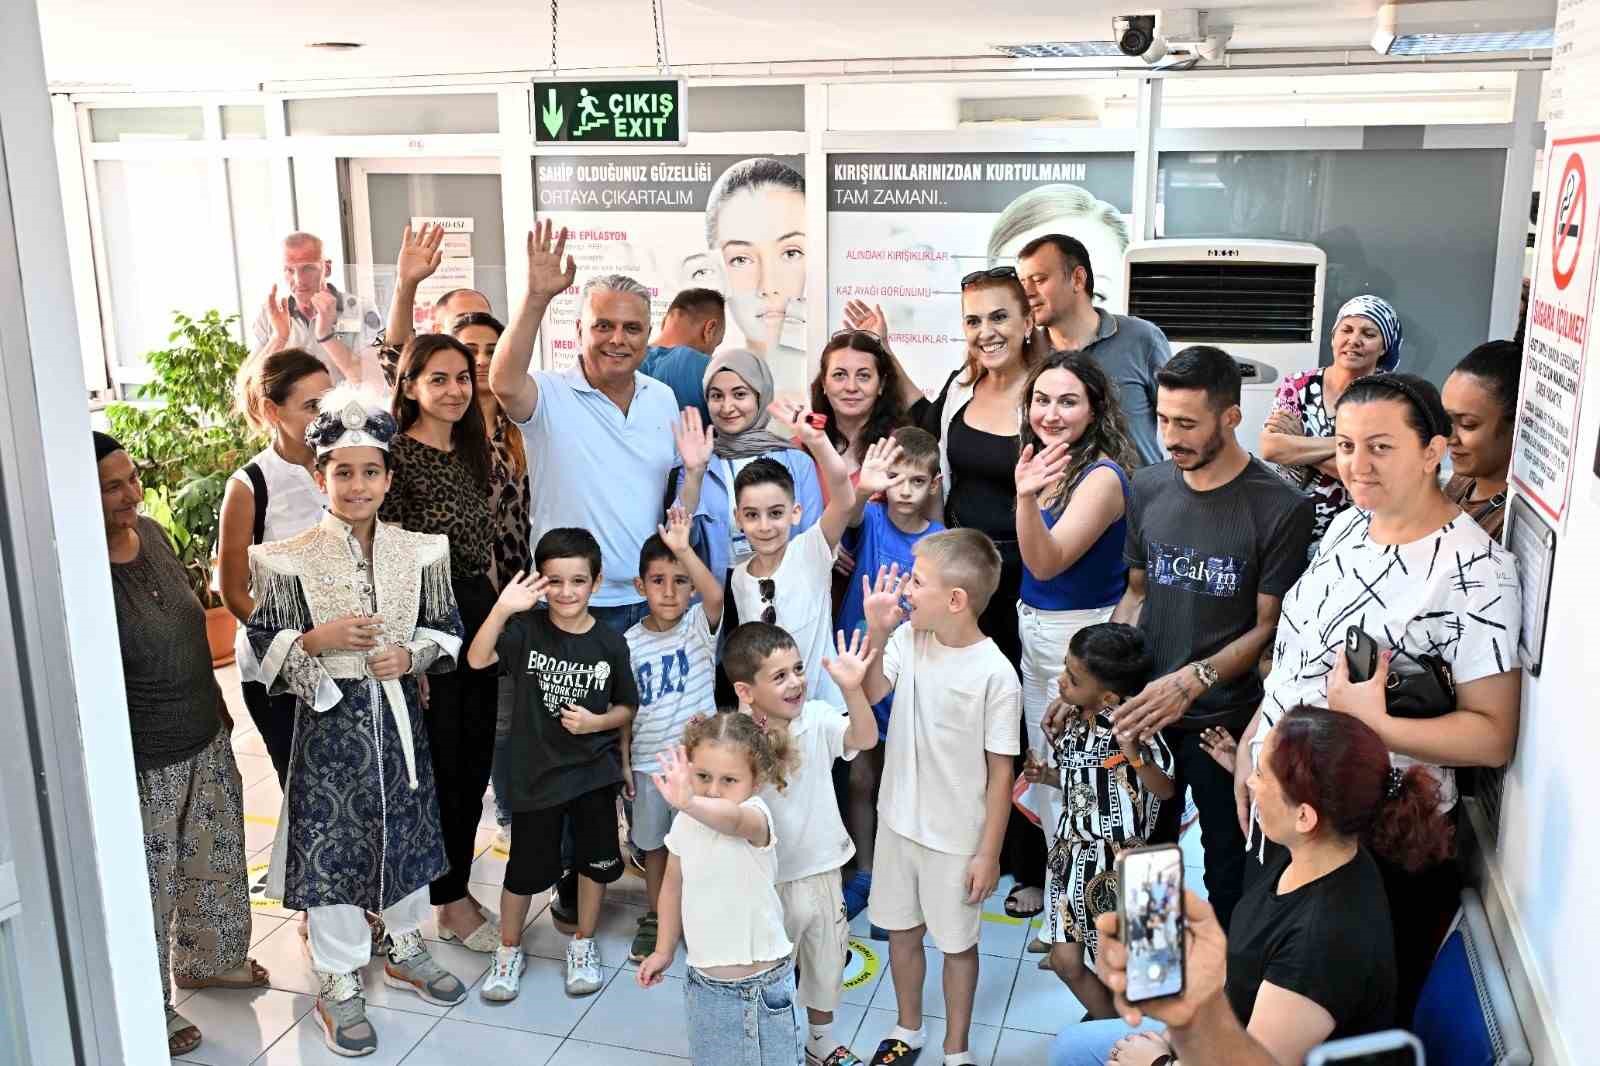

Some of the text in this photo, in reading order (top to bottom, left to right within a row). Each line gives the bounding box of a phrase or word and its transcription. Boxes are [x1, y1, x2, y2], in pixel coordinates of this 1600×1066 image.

[608, 93, 674, 118] ÇIKIŞ
[614, 118, 667, 138] EXIT
[539, 162, 712, 183] SAHİP OLDUĞUNUZ GÜZELLİĞİ
[834, 163, 1087, 184] KIRIŞIKLIKLARINIZDAN KURTULMANIN
[540, 190, 694, 209] ORTAYA ÇIKARTALIM
[834, 189, 948, 206] TAM ZAMANI..
[580, 231, 627, 241] EPİLASYON
[835, 285, 852, 297] KAZ
[527, 650, 606, 691] BROOKLYN
[550, 683, 571, 696] YORK
[572, 688, 589, 698] CITY
